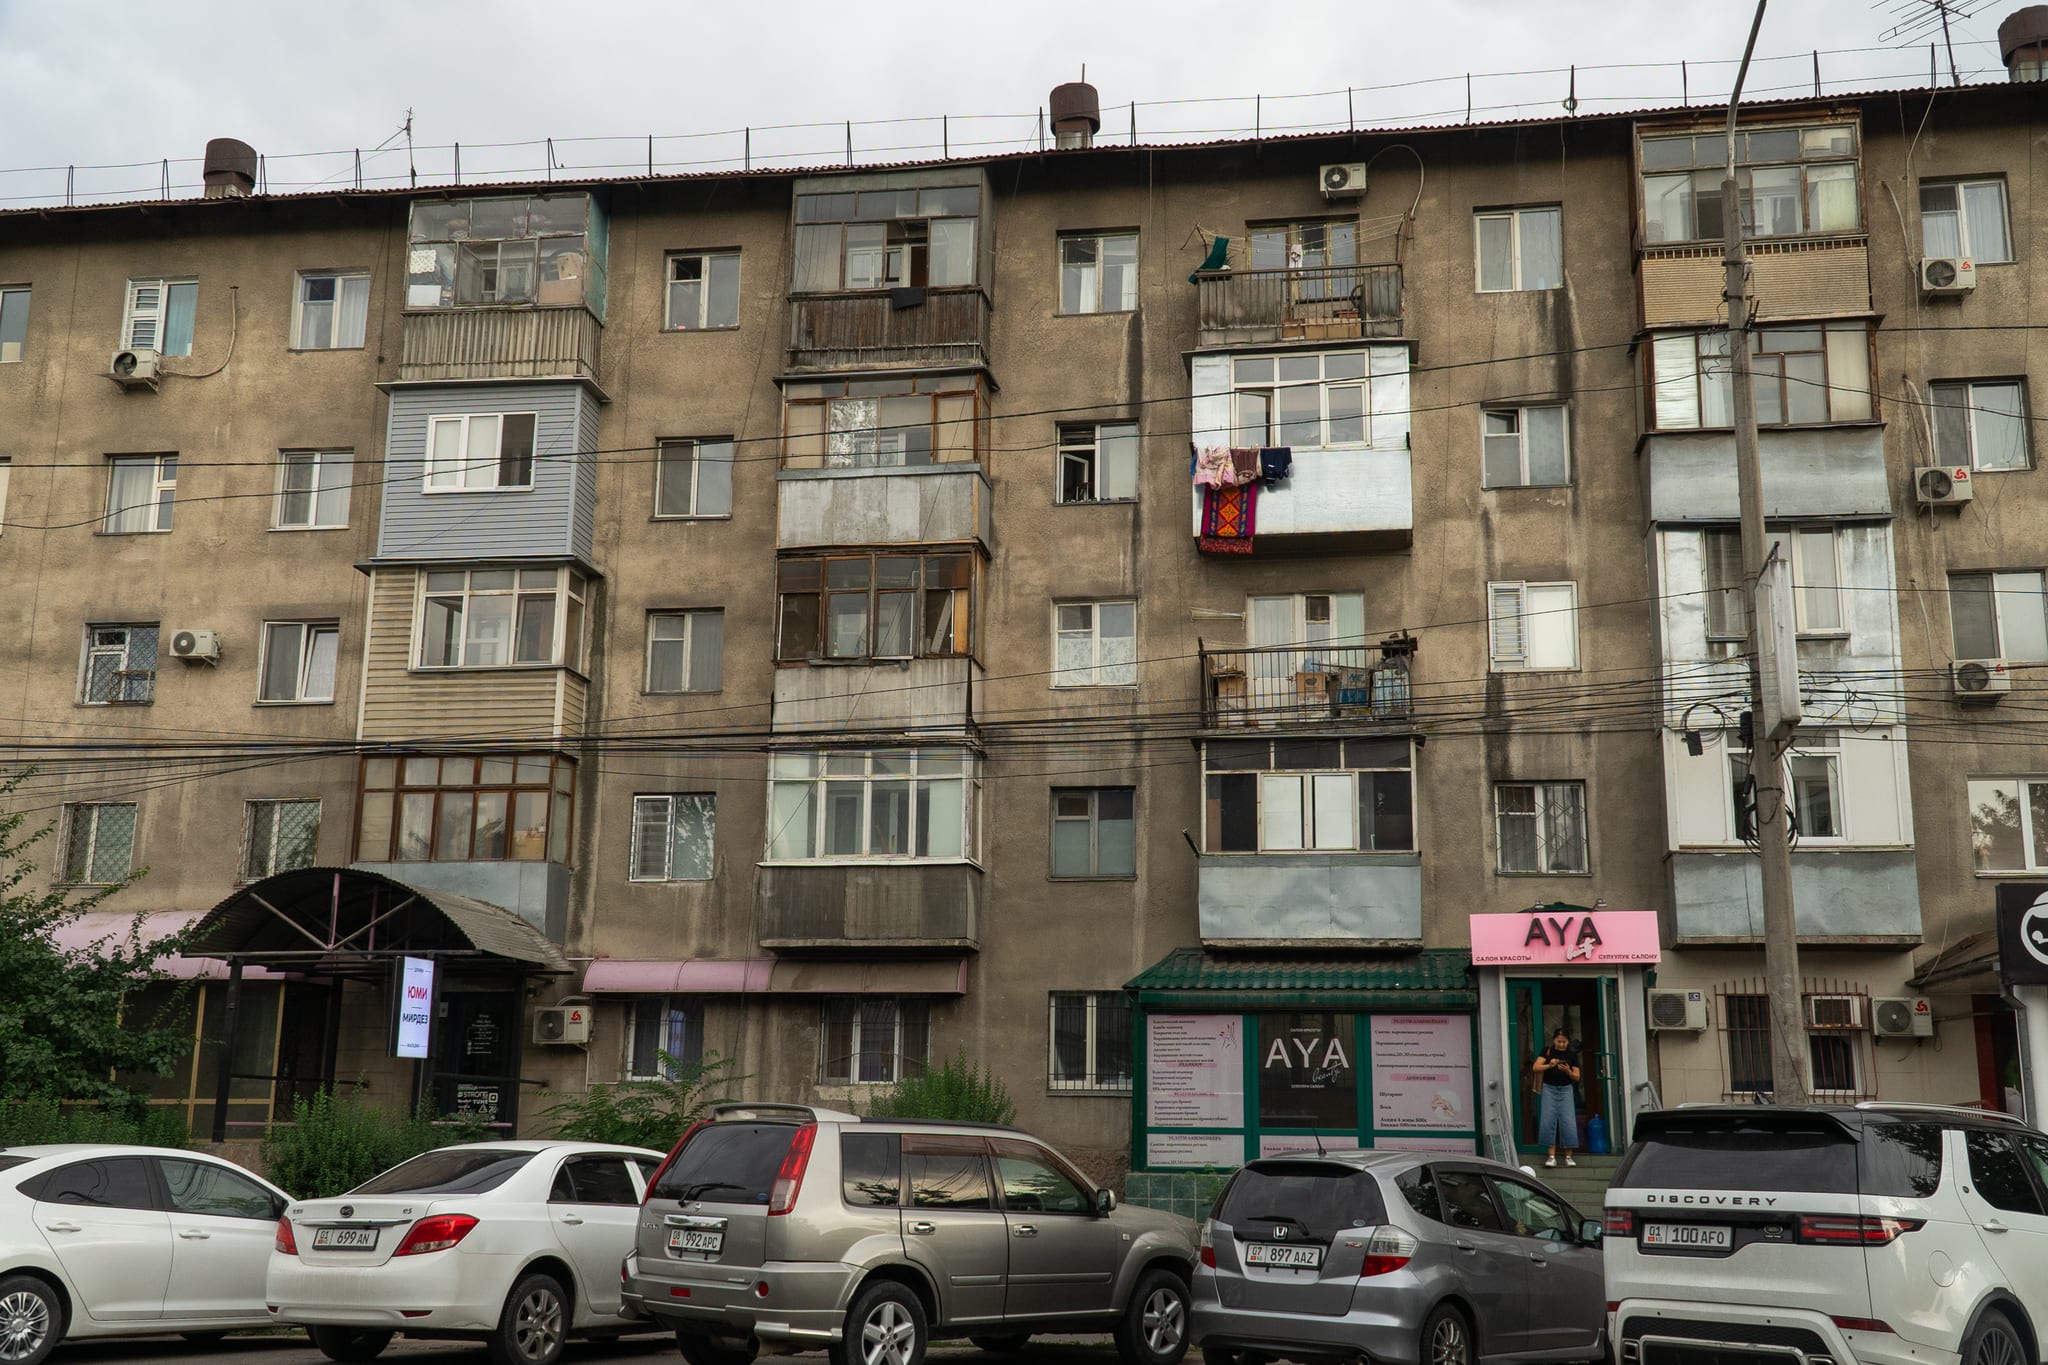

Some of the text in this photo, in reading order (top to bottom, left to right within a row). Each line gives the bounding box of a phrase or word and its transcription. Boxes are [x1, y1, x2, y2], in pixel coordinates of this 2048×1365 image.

[1525, 916, 1602, 946] AYA
[407, 986, 428, 1000] ЮМИ
[402, 1012, 428, 1025] МИРДЕЗ
[1264, 1038, 1350, 1068] AYA
[1647, 1194, 1777, 1206] DISCOVERY
[320, 1230, 370, 1244] 01 699 AN
[685, 1233, 702, 1247] 992
[702, 1236, 718, 1249] APC
[1649, 1226, 1661, 1236] 01
[1671, 1227, 1699, 1243] 100
[1252, 1246, 1263, 1256] 07
[1270, 1247, 1292, 1263] 897
[1293, 1251, 1314, 1264] AAZ
